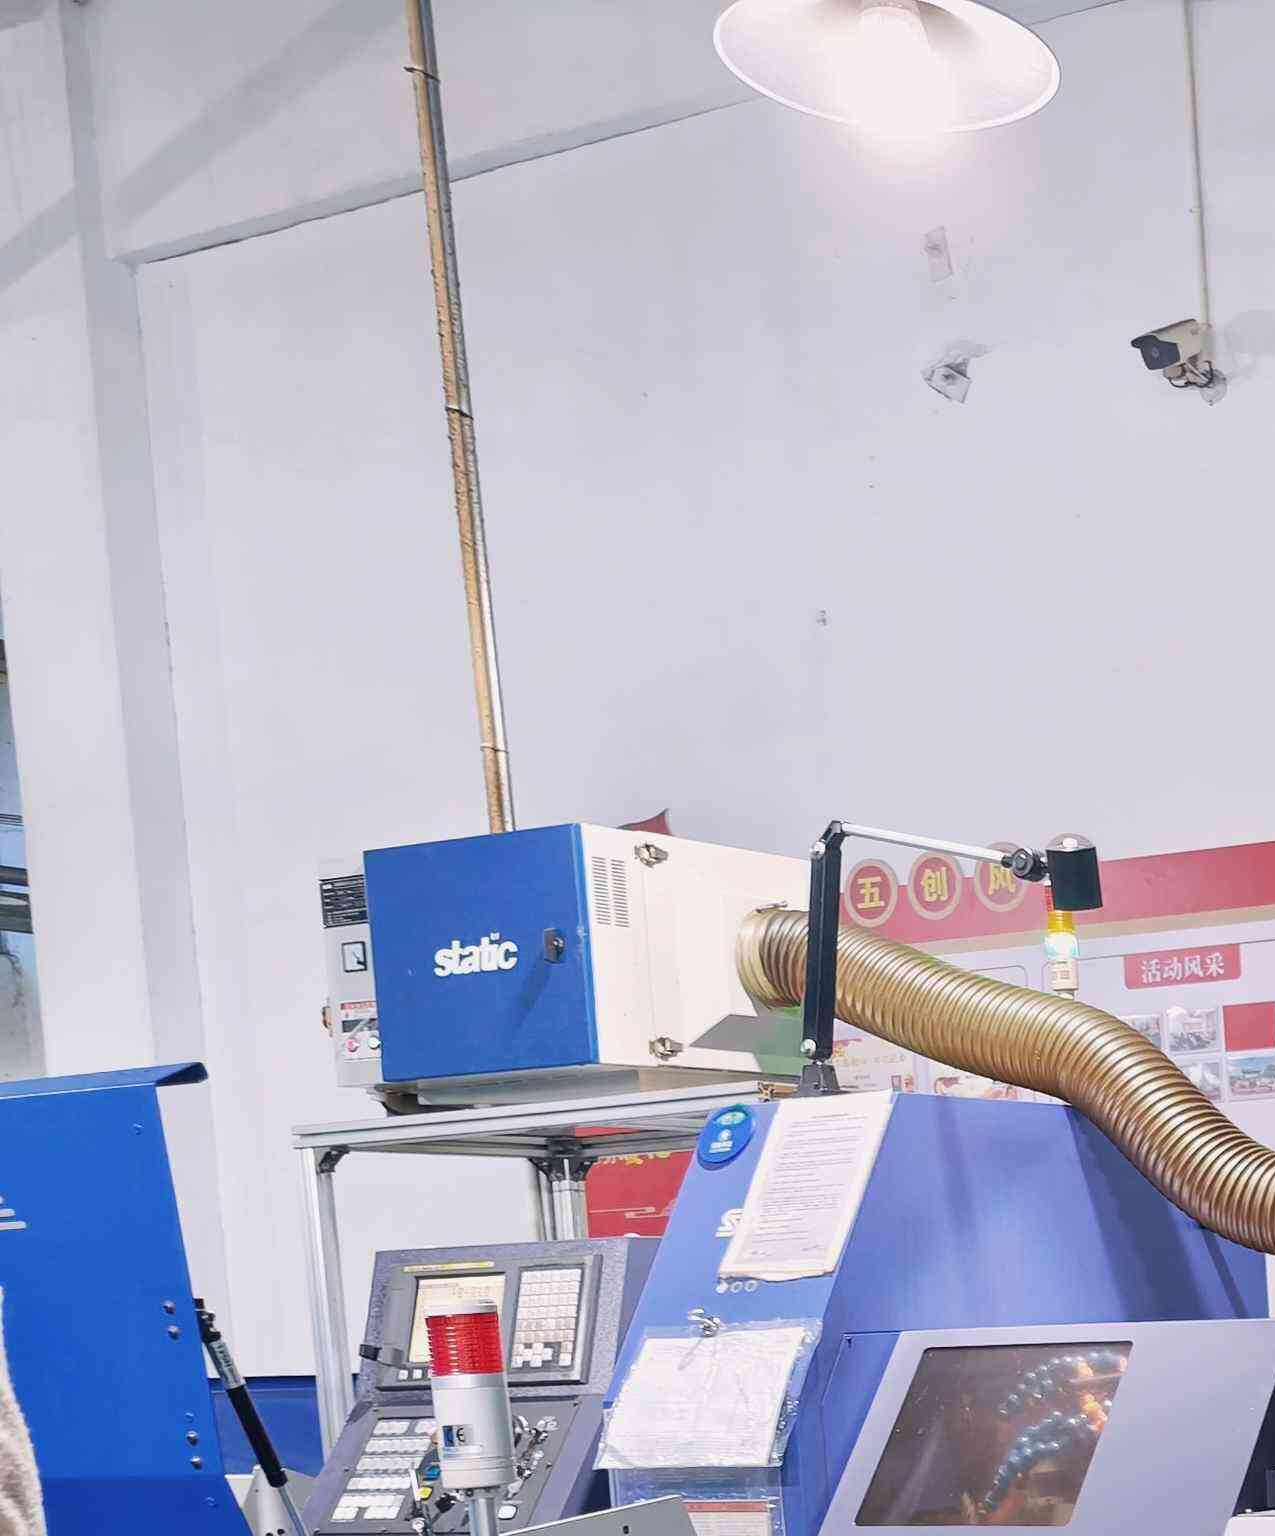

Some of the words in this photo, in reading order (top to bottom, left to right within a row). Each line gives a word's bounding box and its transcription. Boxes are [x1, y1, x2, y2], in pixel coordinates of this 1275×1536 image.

[434, 932, 518, 977] static
[1141, 951, 1225, 984] 活动风采
